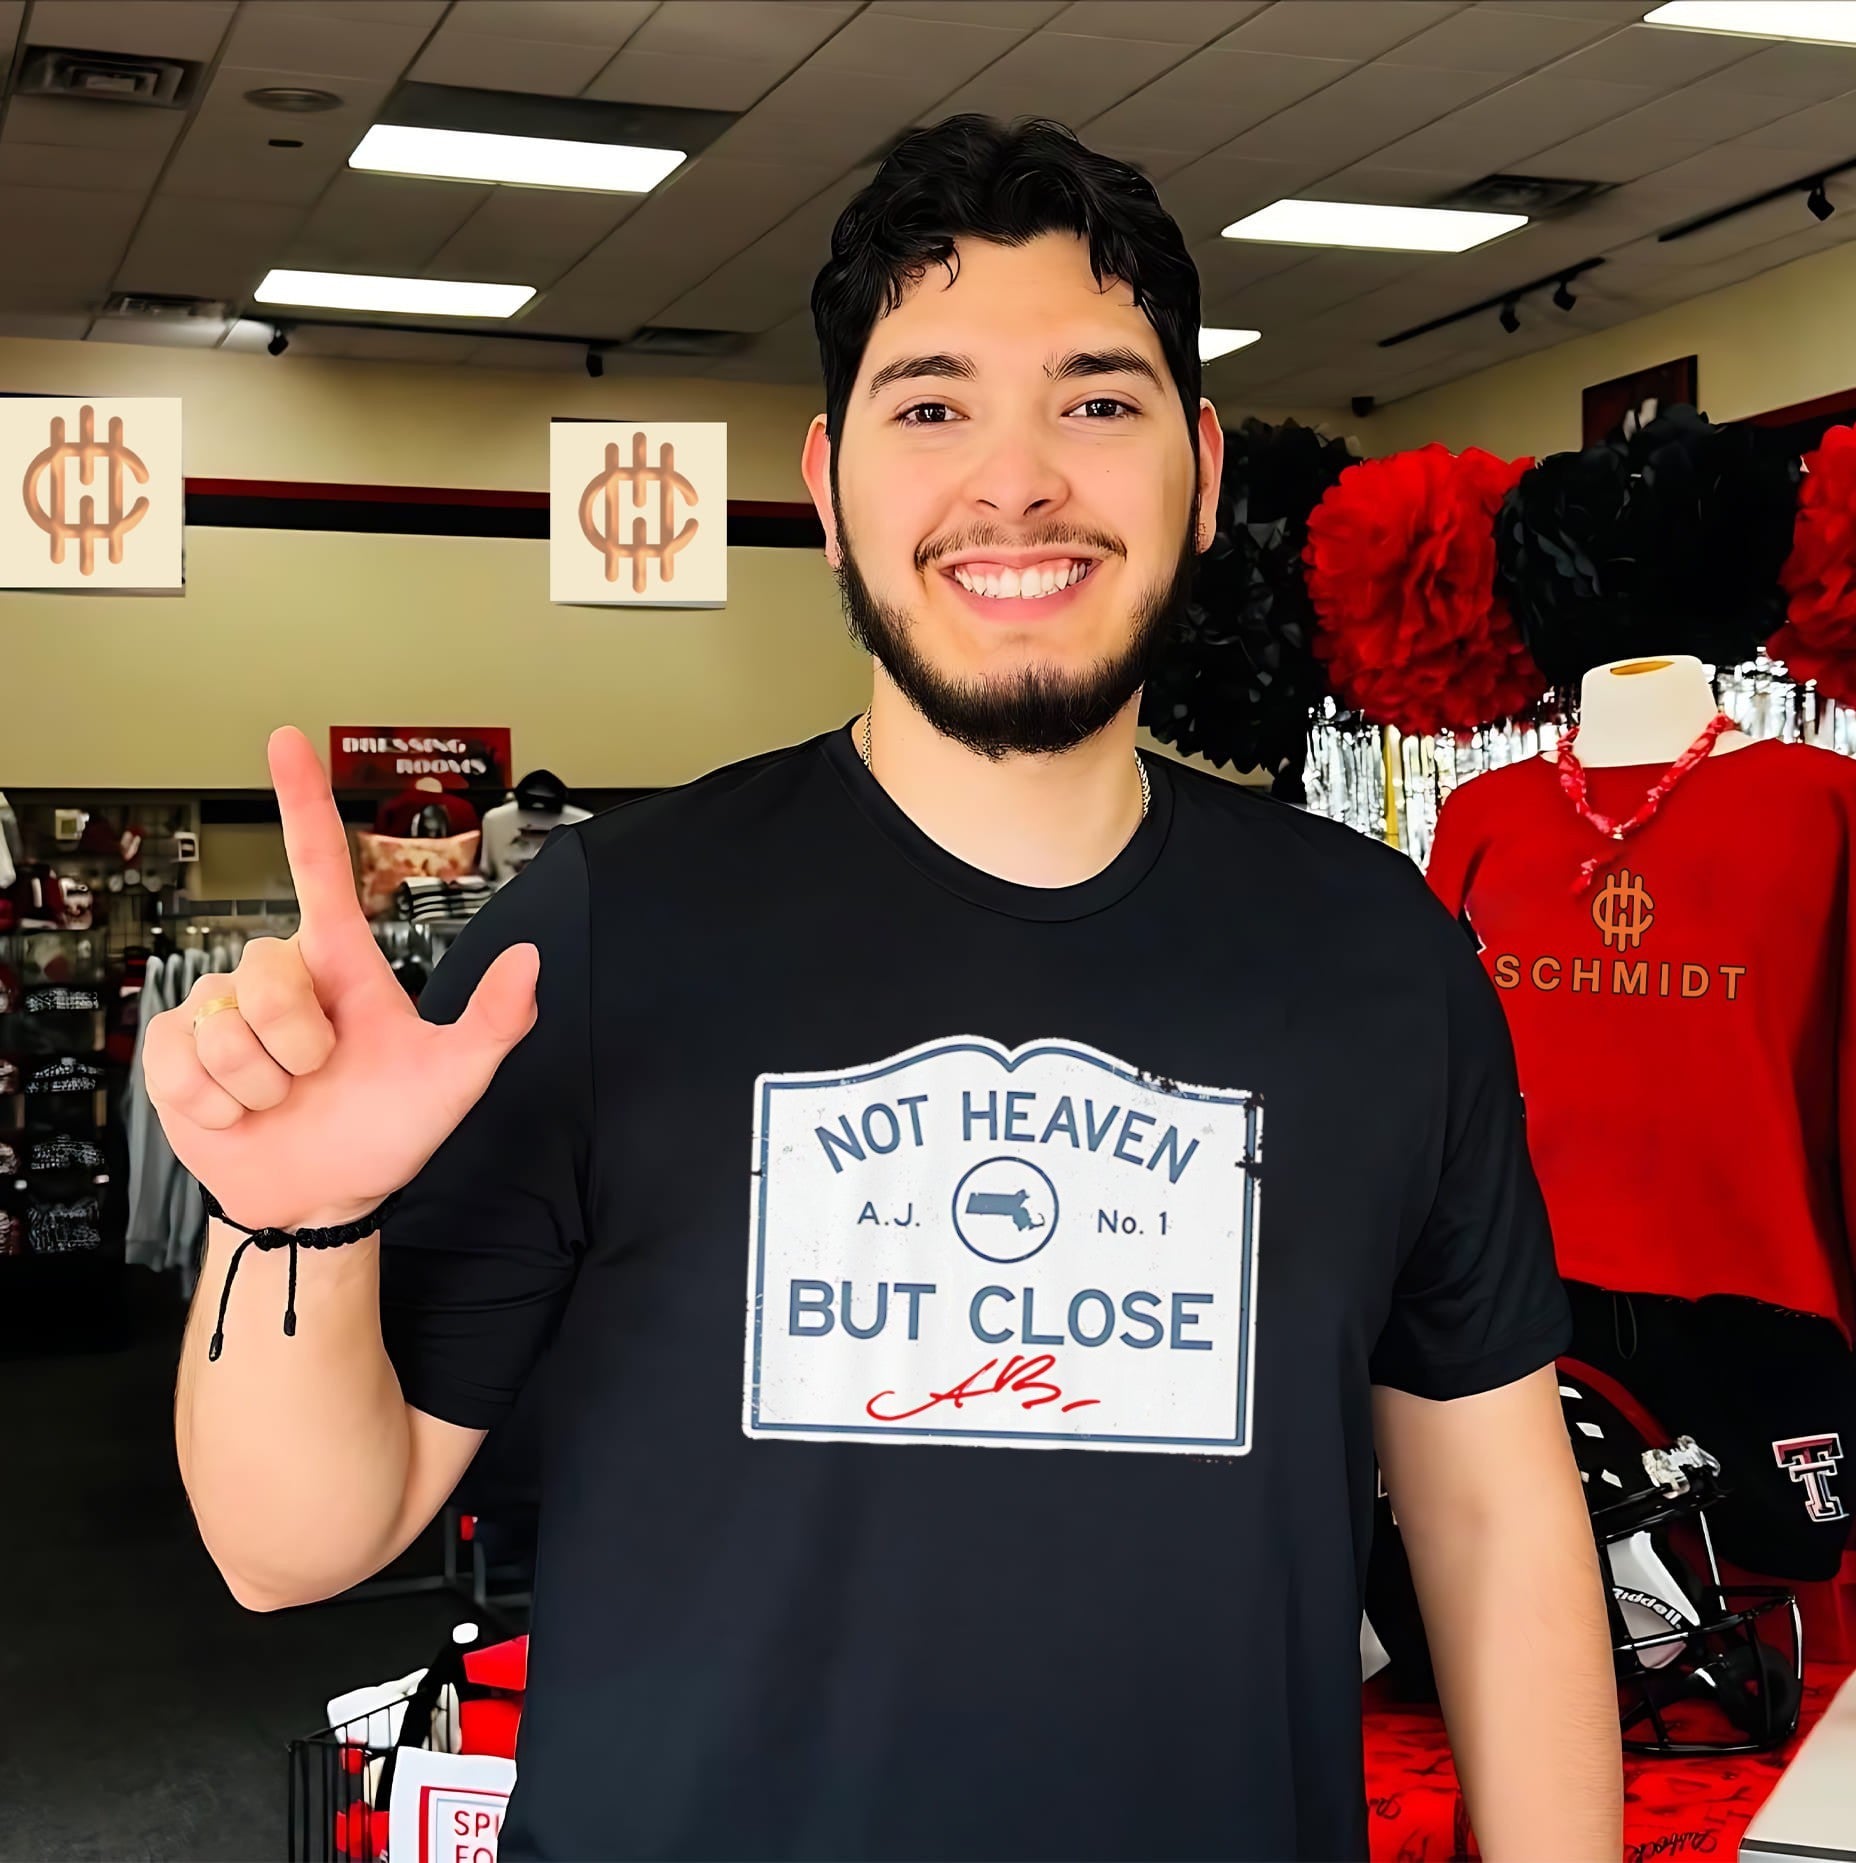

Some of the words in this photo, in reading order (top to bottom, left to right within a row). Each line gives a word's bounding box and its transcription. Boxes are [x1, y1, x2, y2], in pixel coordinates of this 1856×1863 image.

[342, 737, 466, 754] DRESSING
[396, 758, 487, 775] ROOMS
[1494, 954, 1746, 1000] SCHMIDT
[814, 1094, 929, 1174] NOT
[962, 1090, 1199, 1184] HEAVEN
[857, 1201, 921, 1228] A.J.
[1098, 1210, 1145, 1235] No.
[1159, 1211, 1168, 1236] 1
[789, 1279, 936, 1340] BUT
[969, 1285, 1214, 1351] CLOSE
